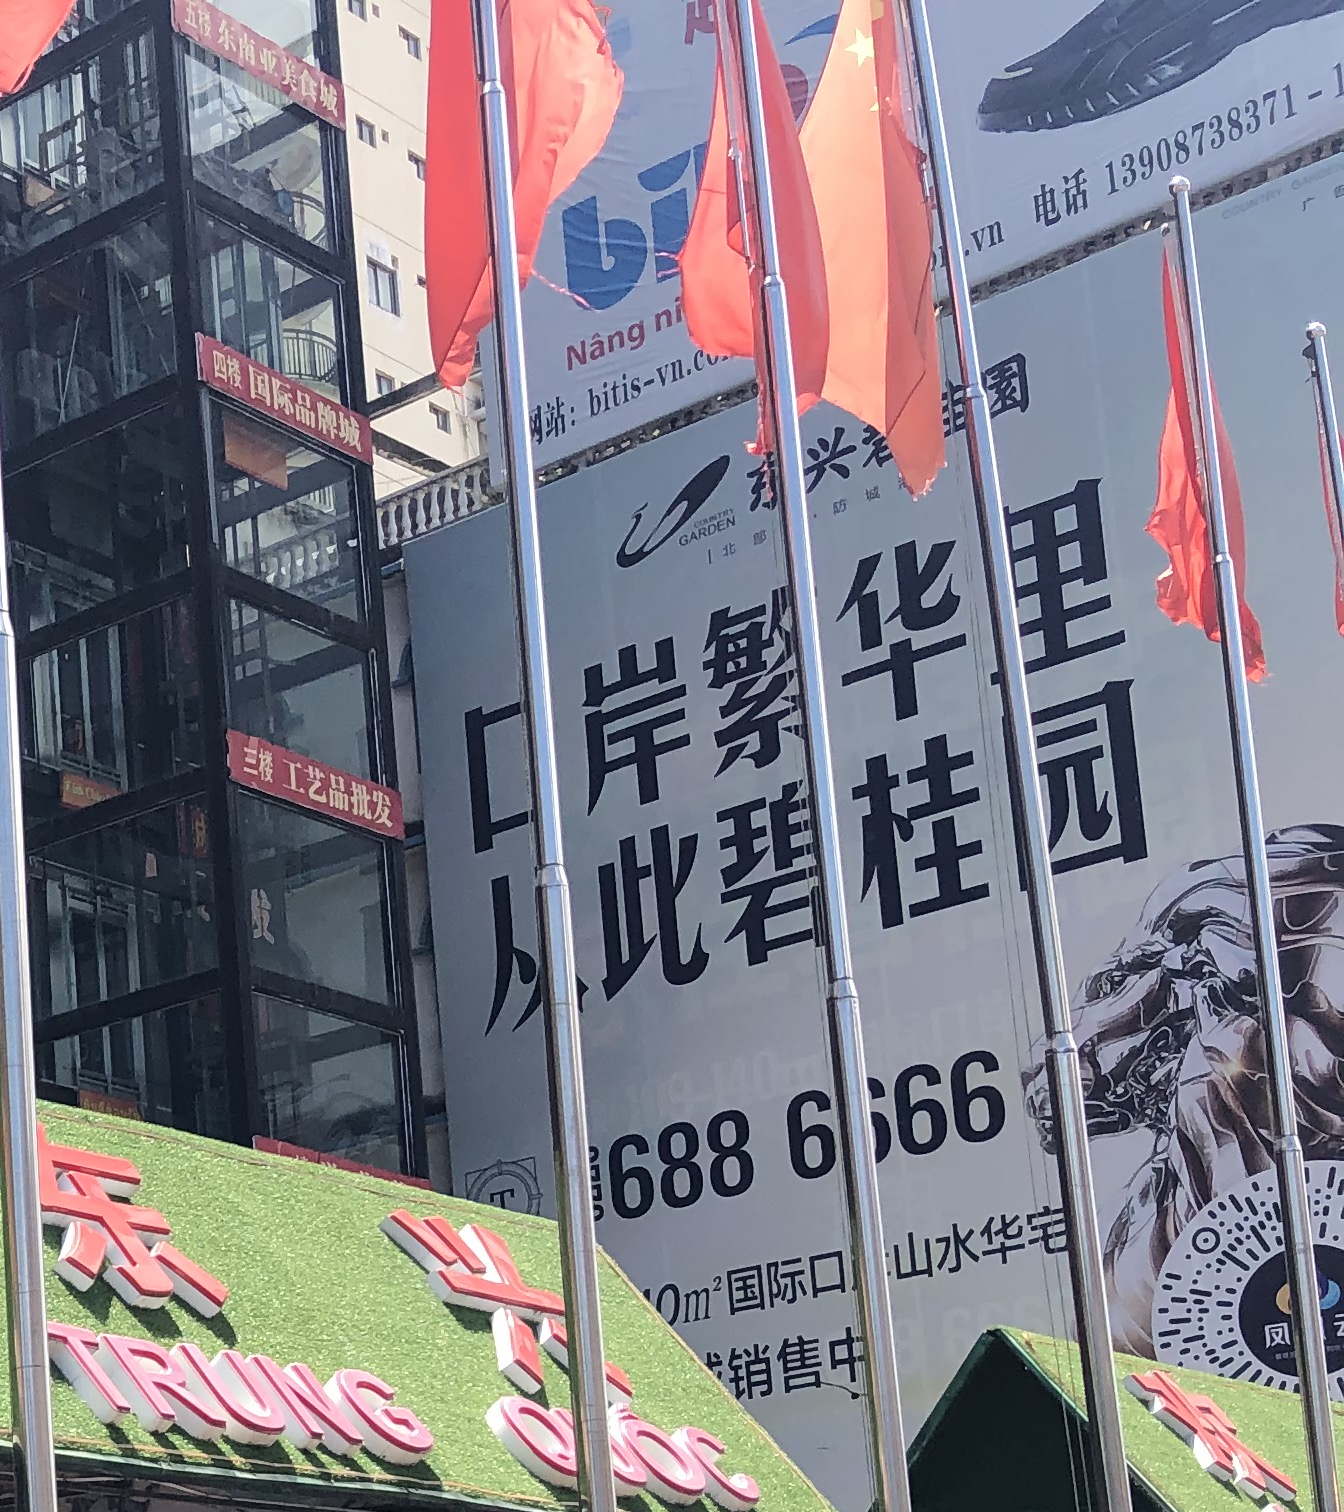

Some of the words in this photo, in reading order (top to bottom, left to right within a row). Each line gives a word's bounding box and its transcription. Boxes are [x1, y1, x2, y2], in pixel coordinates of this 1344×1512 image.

[216, 17, 340, 119] 东南亚美食城
[1033, 167, 1089, 228] 电话
[565, 320, 645, 372] Nâng
[654, 297, 684, 333] ni
[587, 350, 736, 418] bitis-vn.co
[213, 349, 243, 390] 四楼
[248, 365, 362, 451] 国际品牌城
[678, 514, 737, 548] GARDEN
[464, 478, 1128, 856] 口岸繁华里
[243, 746, 275, 783] 三楼
[282, 757, 393, 828] 工艺品批发
[482, 679, 1150, 1038] 从此碧桂园
[608, 1108, 755, 1220] 688
[48, 1320, 434, 1465] TRUNG
